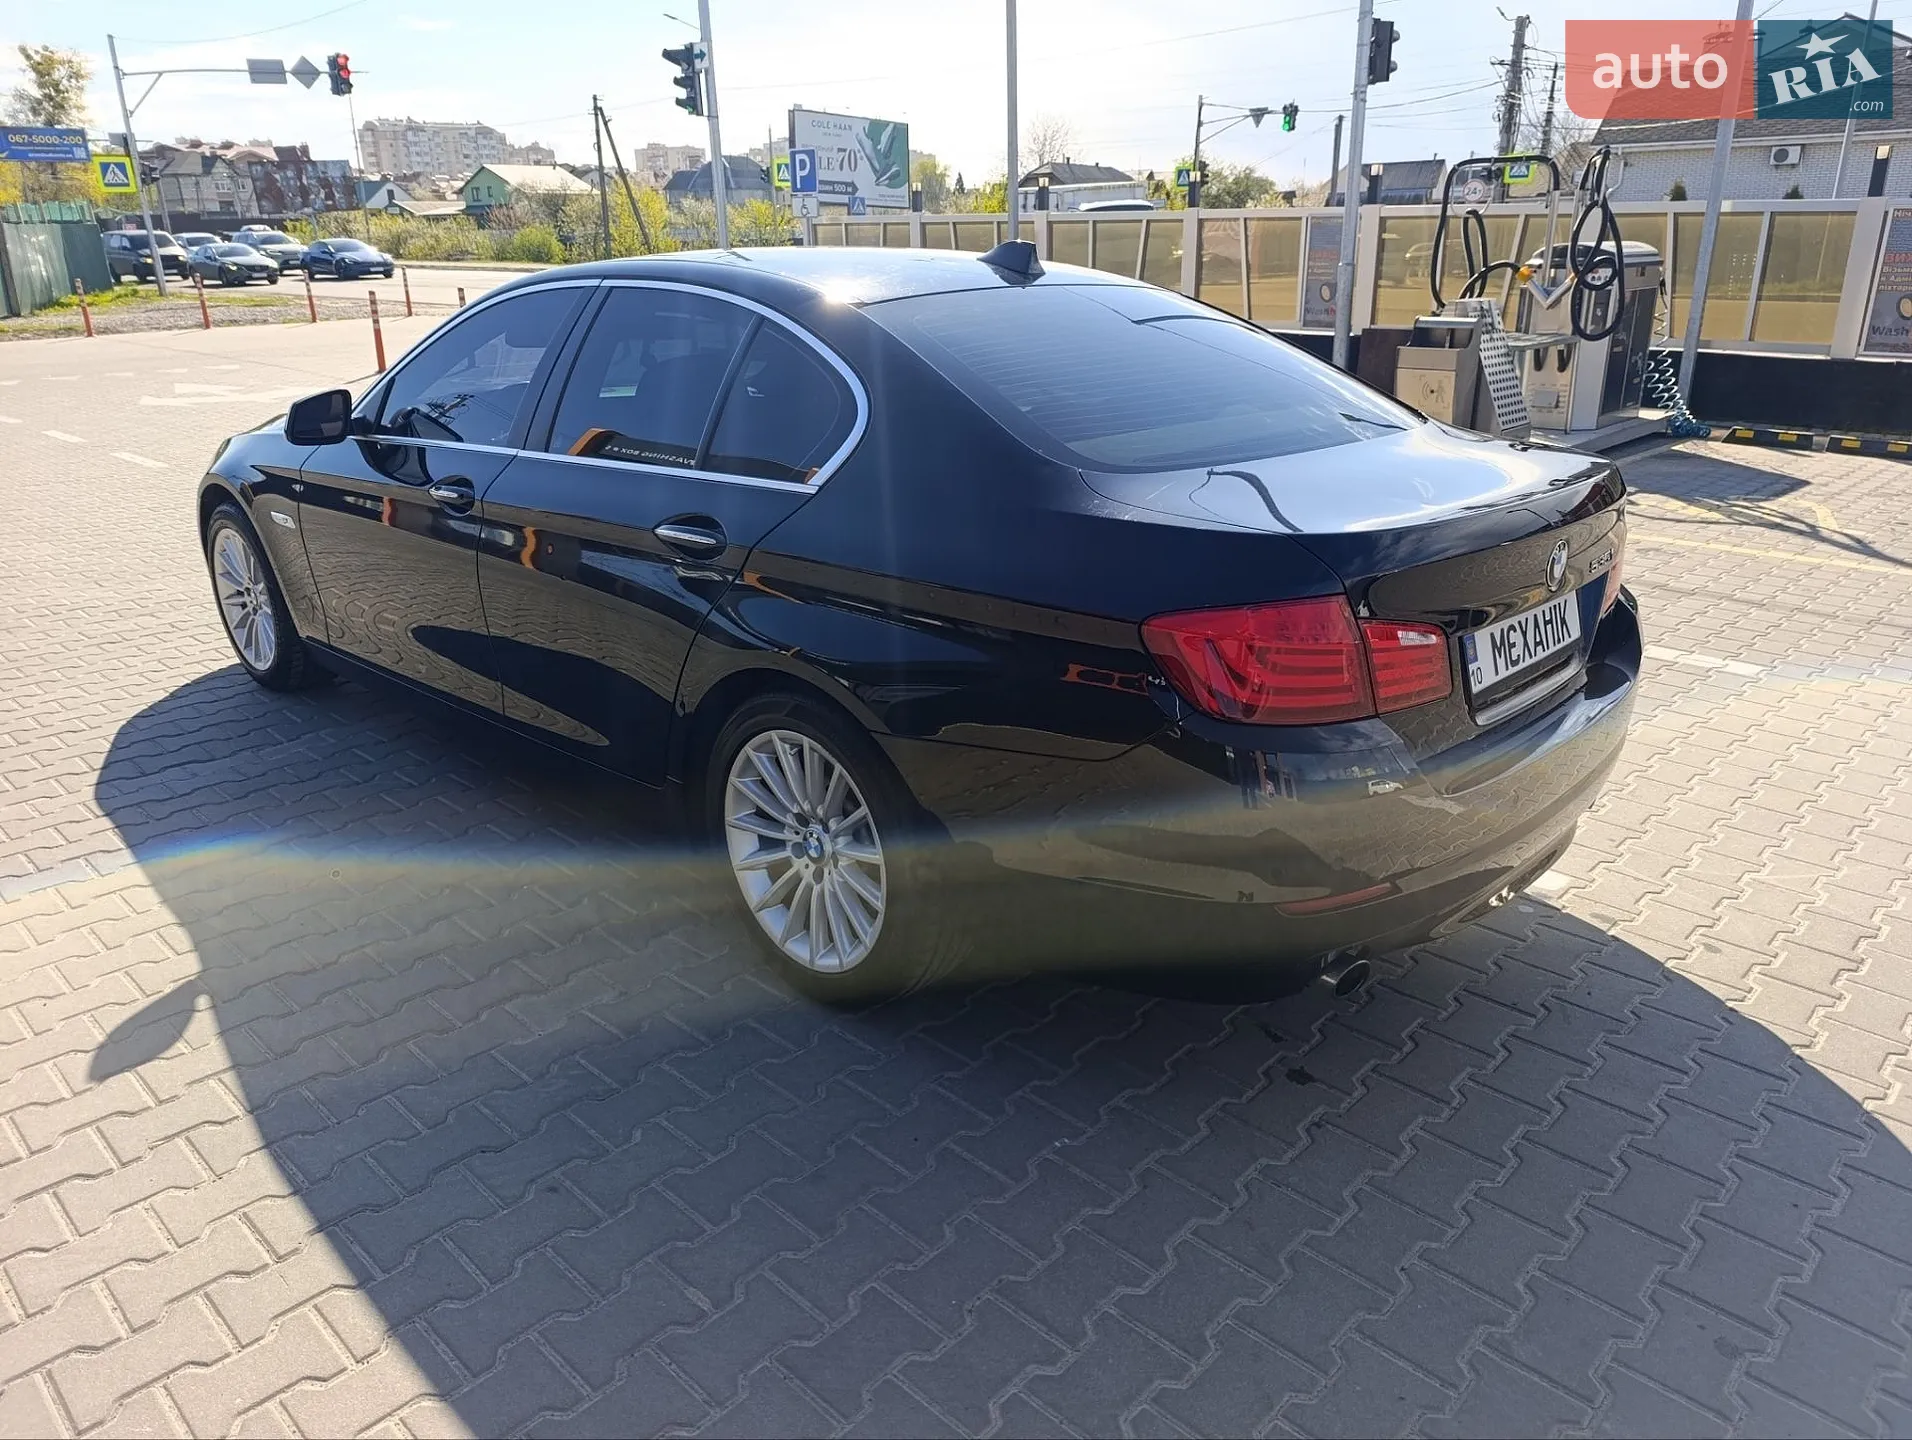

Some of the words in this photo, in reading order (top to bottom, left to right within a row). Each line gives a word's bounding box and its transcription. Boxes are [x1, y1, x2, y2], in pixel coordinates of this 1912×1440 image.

[811, 119, 831, 130] COLE
[832, 122, 853, 132] HAAN
[8, 134, 83, 144] 067-5000-200
[795, 153, 810, 189] P
[818, 156, 835, 171] LE
[834, 183, 847, 192] 500
[1489, 599, 1572, 677] МЄХАНІК
[1470, 666, 1483, 687] 10
